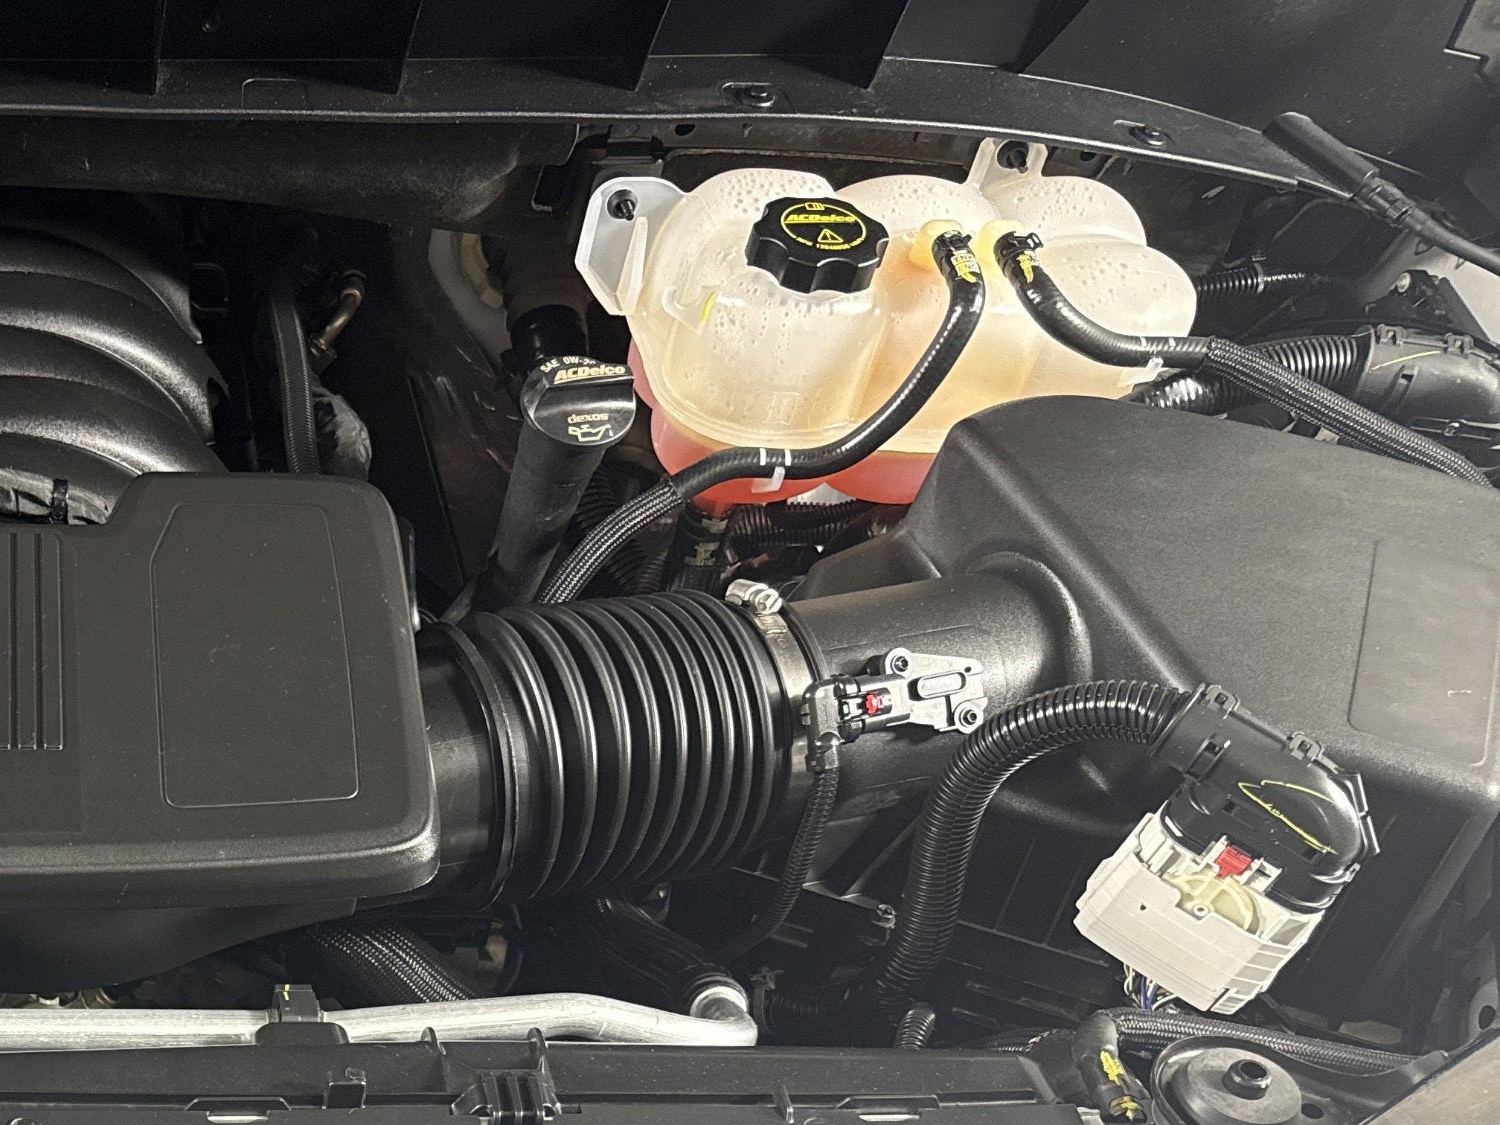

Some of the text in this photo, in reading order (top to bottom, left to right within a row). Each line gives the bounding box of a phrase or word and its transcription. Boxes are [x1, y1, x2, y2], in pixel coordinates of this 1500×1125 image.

[785, 213, 856, 223] ACDelco
[540, 359, 560, 373] SAE
[553, 365, 625, 382] ACDelco
[567, 413, 609, 424] dexos
